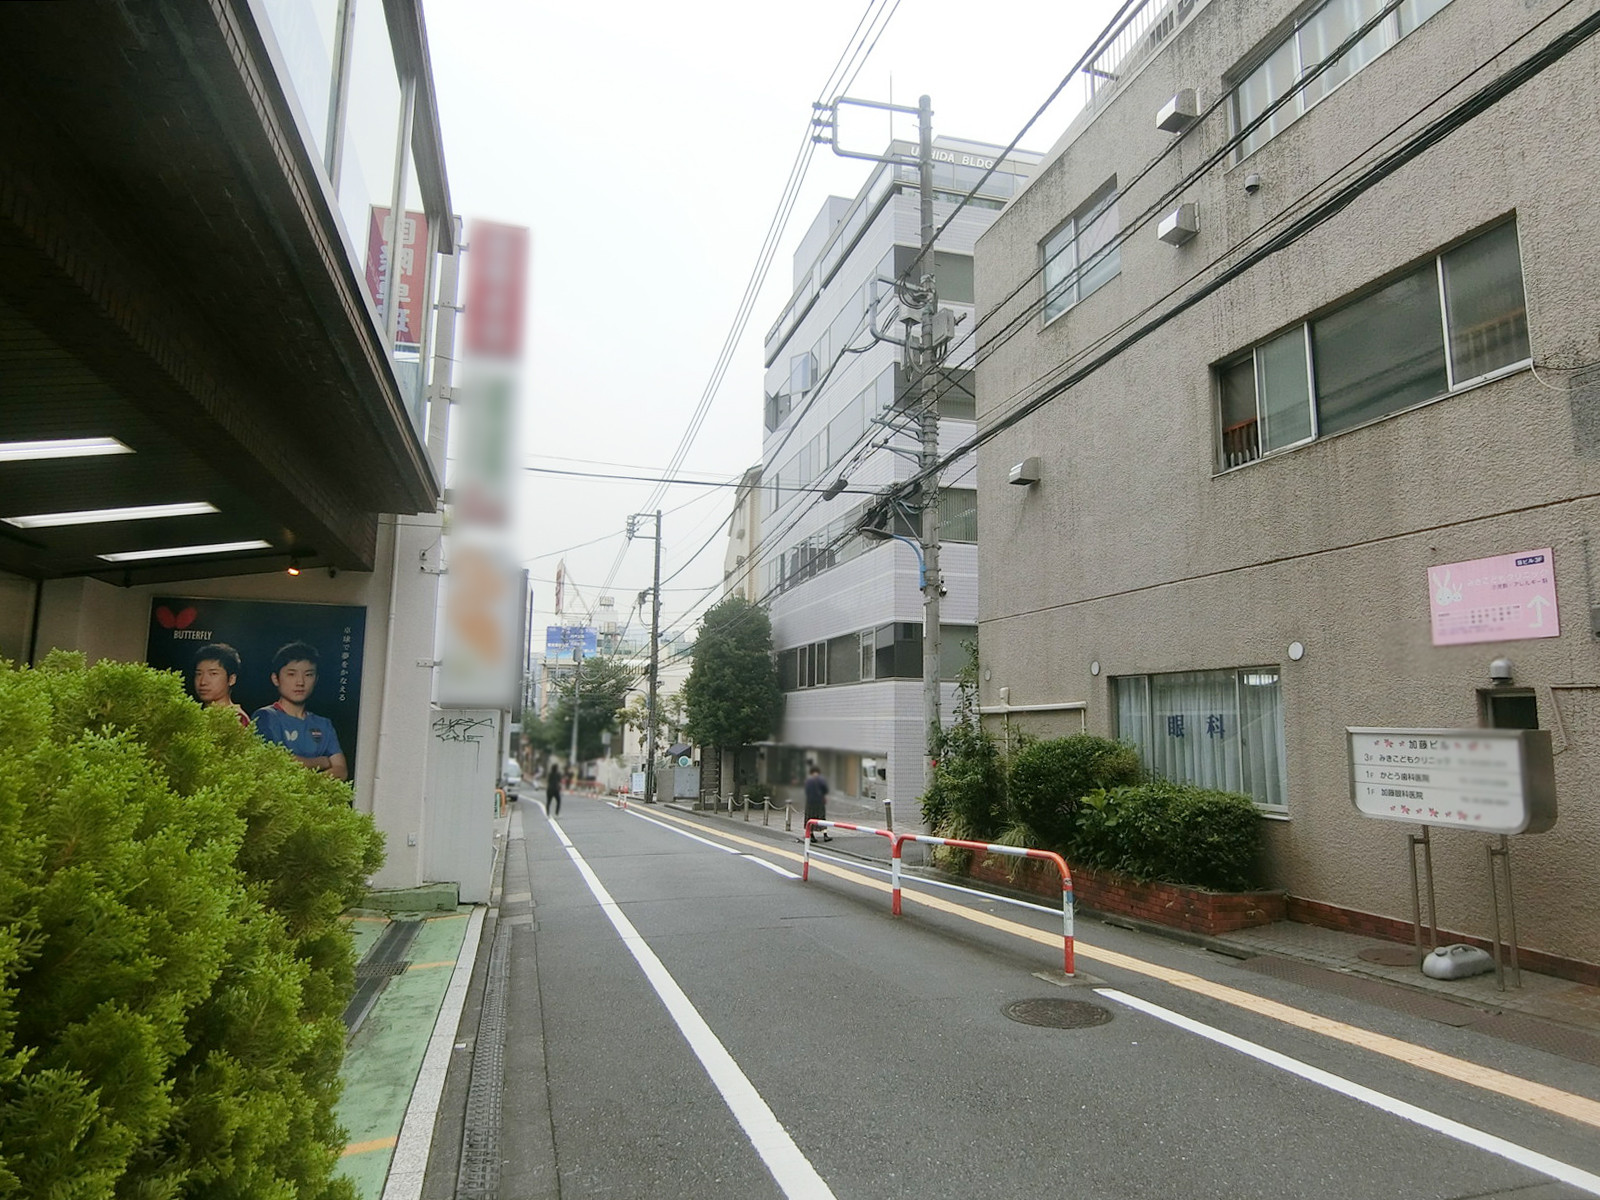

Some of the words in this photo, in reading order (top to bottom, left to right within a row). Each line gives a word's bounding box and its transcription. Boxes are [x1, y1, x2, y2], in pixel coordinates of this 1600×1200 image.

[910, 146, 955, 162] UHIDA
[962, 155, 994, 170] BLDG
[173, 630, 213, 640] BUTTERFLY
[1167, 713, 1226, 739] 眼科
[1364, 752, 1374, 762] 3F
[1365, 770, 1374, 778] 1F
[1366, 786, 1375, 795] 1F
